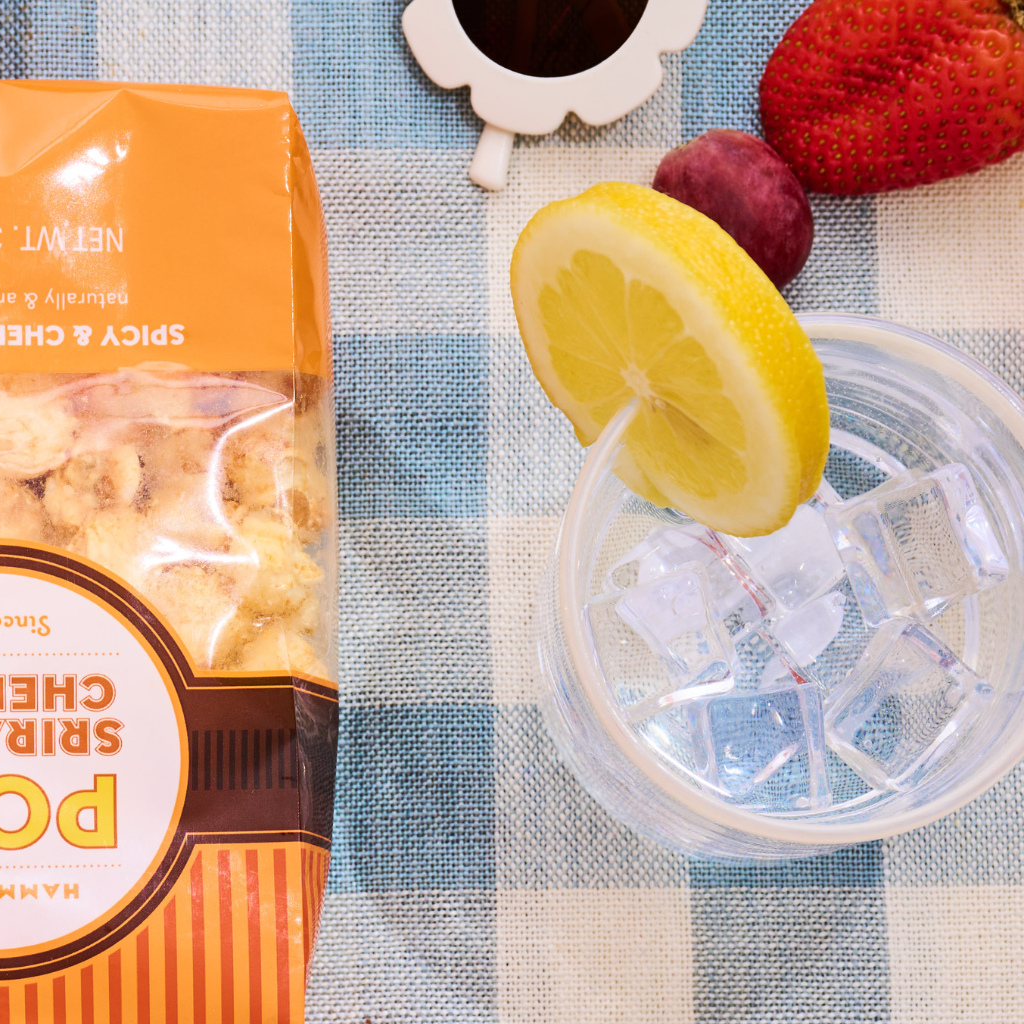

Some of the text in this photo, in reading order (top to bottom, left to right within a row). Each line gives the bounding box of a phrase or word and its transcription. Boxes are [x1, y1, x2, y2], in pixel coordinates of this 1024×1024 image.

[13, 224, 65, 250] WT.
[74, 226, 124, 253] NET
[24, 291, 38, 310] &
[45, 288, 128, 310] naturally
[73, 324, 93, 346] &
[100, 323, 184, 346] SPICY
